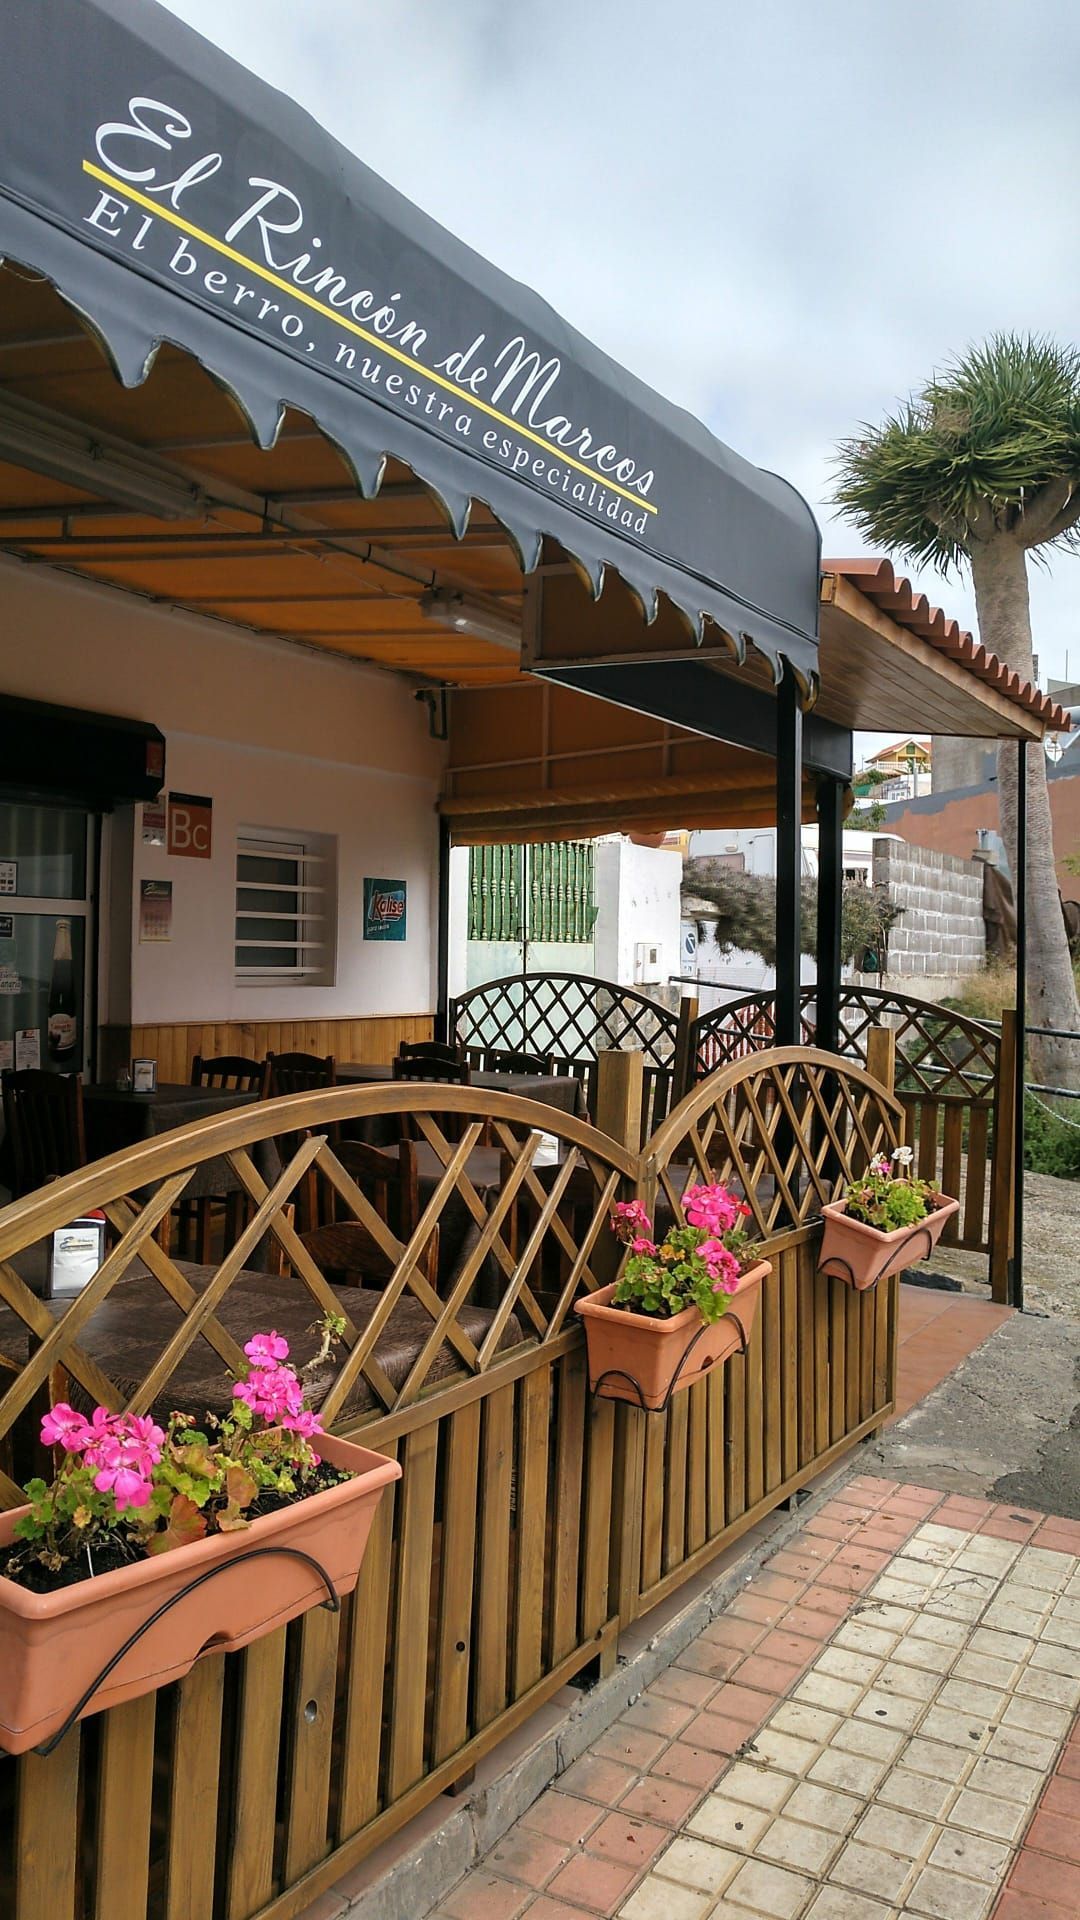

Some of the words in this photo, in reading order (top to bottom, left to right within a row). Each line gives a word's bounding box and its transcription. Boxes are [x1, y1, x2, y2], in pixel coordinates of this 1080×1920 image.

[82, 189, 154, 250] El
[169, 236, 316, 352] berro,
[334, 342, 472, 436] nuestra
[482, 430, 649, 535] especialidad
[95, 96, 223, 210] El
[224, 177, 428, 357] Rincón
[433, 334, 489, 395] de
[491, 336, 656, 497] Marcos
[372, 890, 404, 920] Kalise
